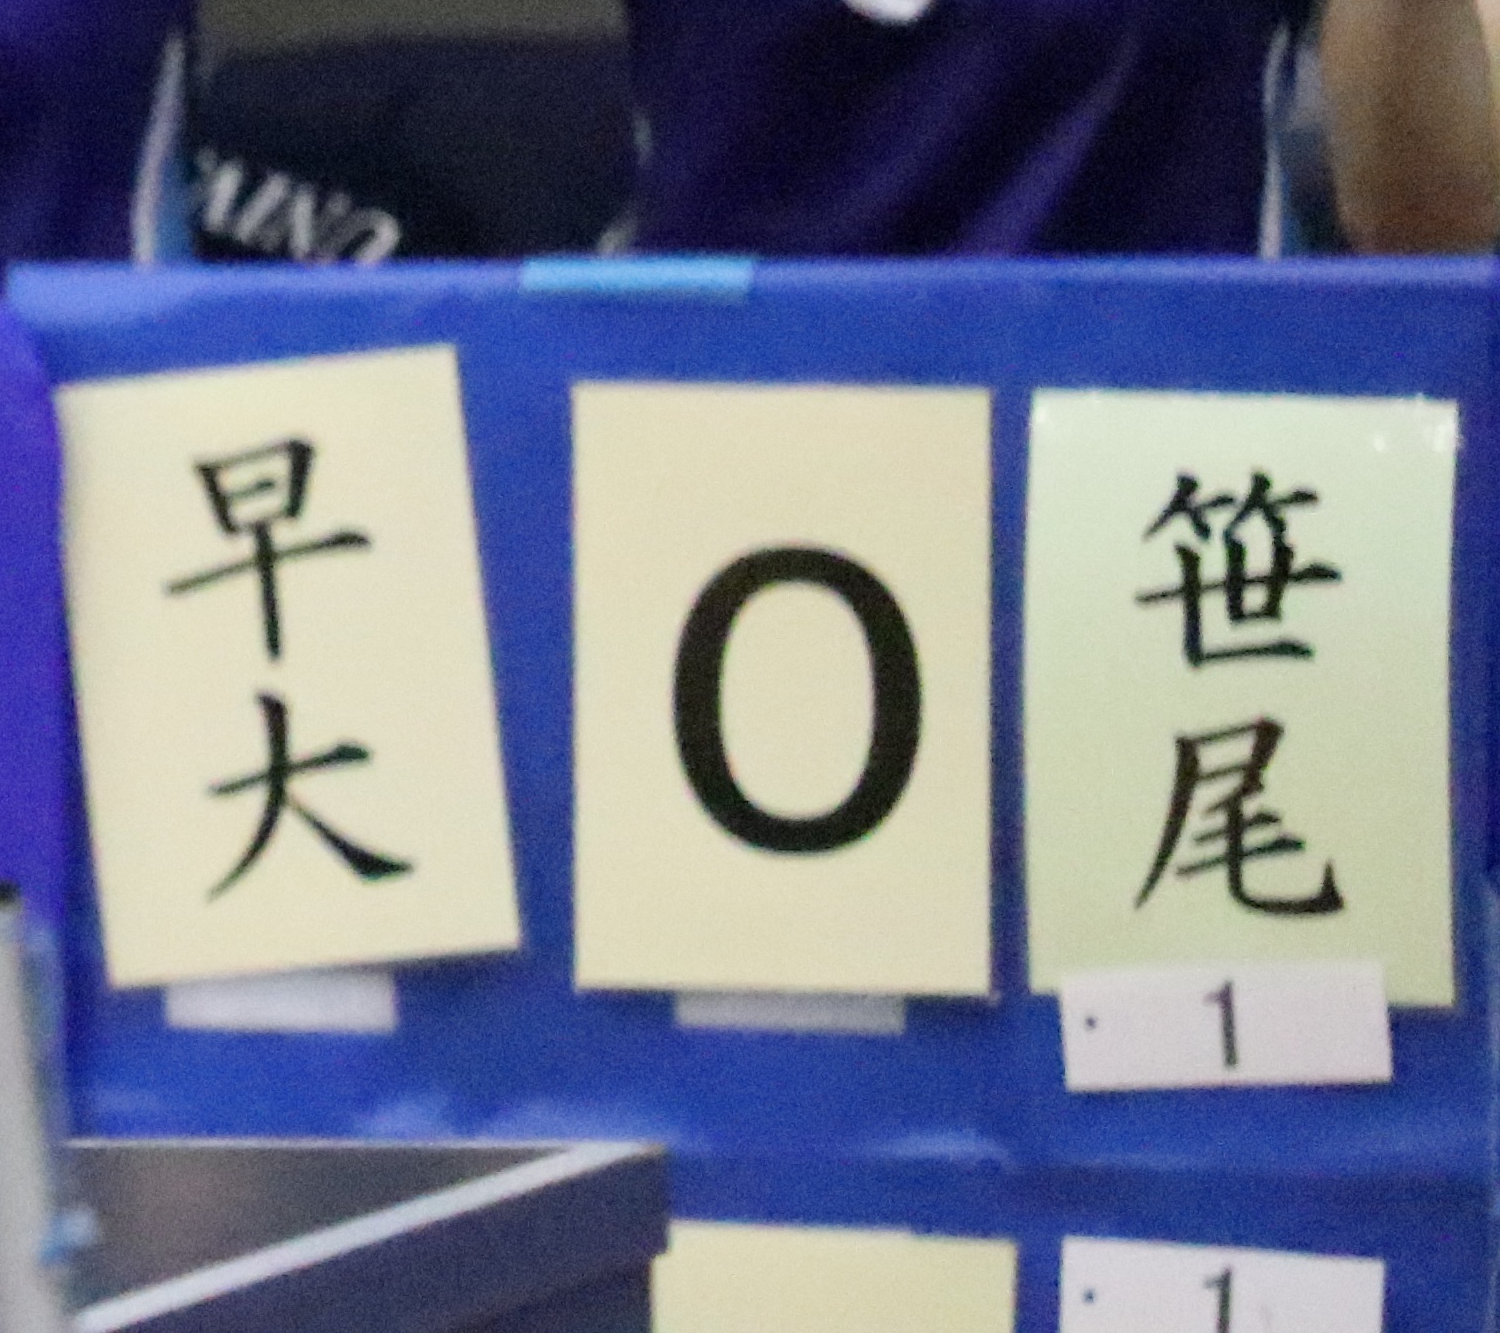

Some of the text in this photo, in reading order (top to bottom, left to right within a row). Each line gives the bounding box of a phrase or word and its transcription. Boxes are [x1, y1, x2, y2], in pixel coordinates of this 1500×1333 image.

[164, 437, 414, 903] 早大
[1133, 471, 1346, 917] 笹尾
[1204, 979, 1238, 1069] 1
[1204, 1265, 1232, 1333] 1
